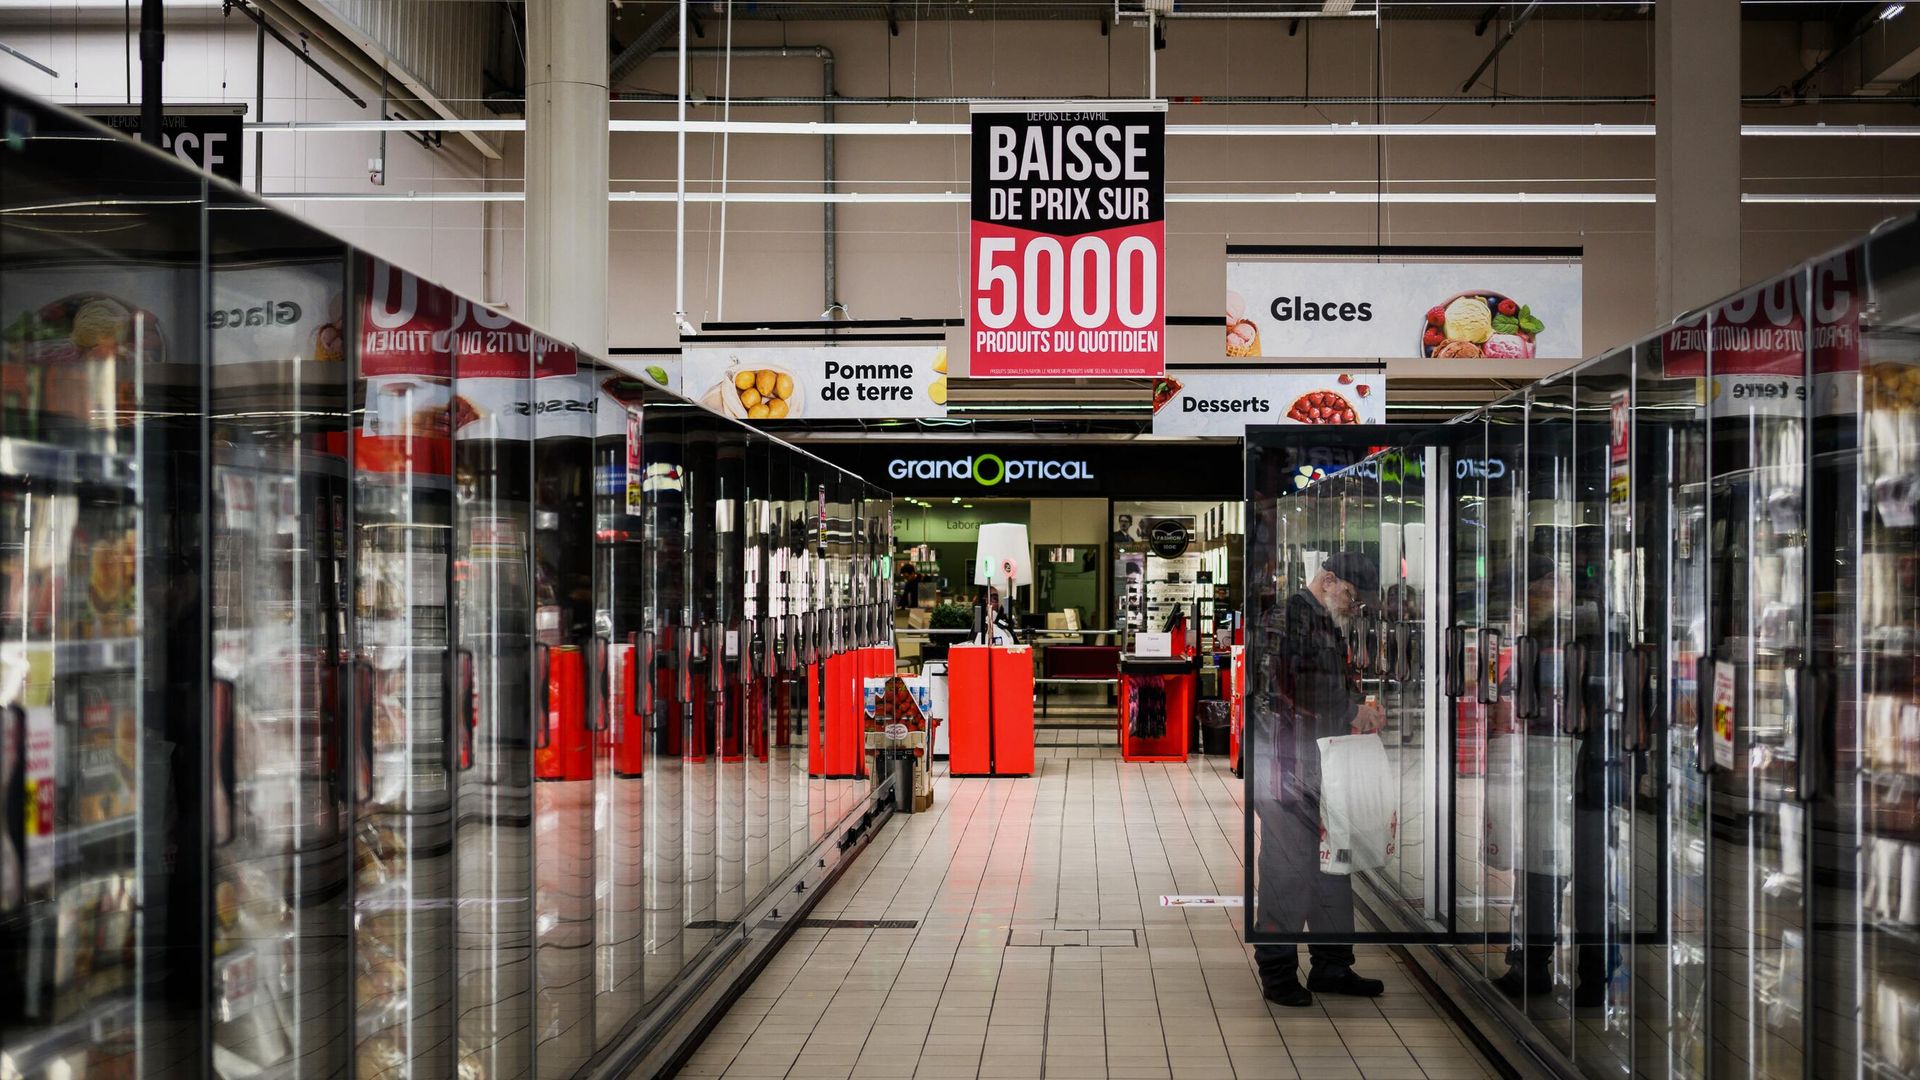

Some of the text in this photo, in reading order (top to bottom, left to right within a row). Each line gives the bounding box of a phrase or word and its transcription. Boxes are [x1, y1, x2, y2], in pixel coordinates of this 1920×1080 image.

[1027, 112, 1059, 121] DEPUIS
[1061, 112, 1071, 121] LE
[1082, 112, 1109, 121] AVRIL
[990, 125, 1150, 181] BAISSE
[990, 188, 1149, 220] DE PRIX SUR
[977, 236, 1157, 329] 5000
[1270, 296, 1373, 322] Glaces
[977, 331, 1158, 354] PRODUITS DU QUOTIDIEN
[825, 361, 913, 379] Pomme
[821, 382, 913, 401] de terre
[1183, 397, 1269, 412] Desserts
